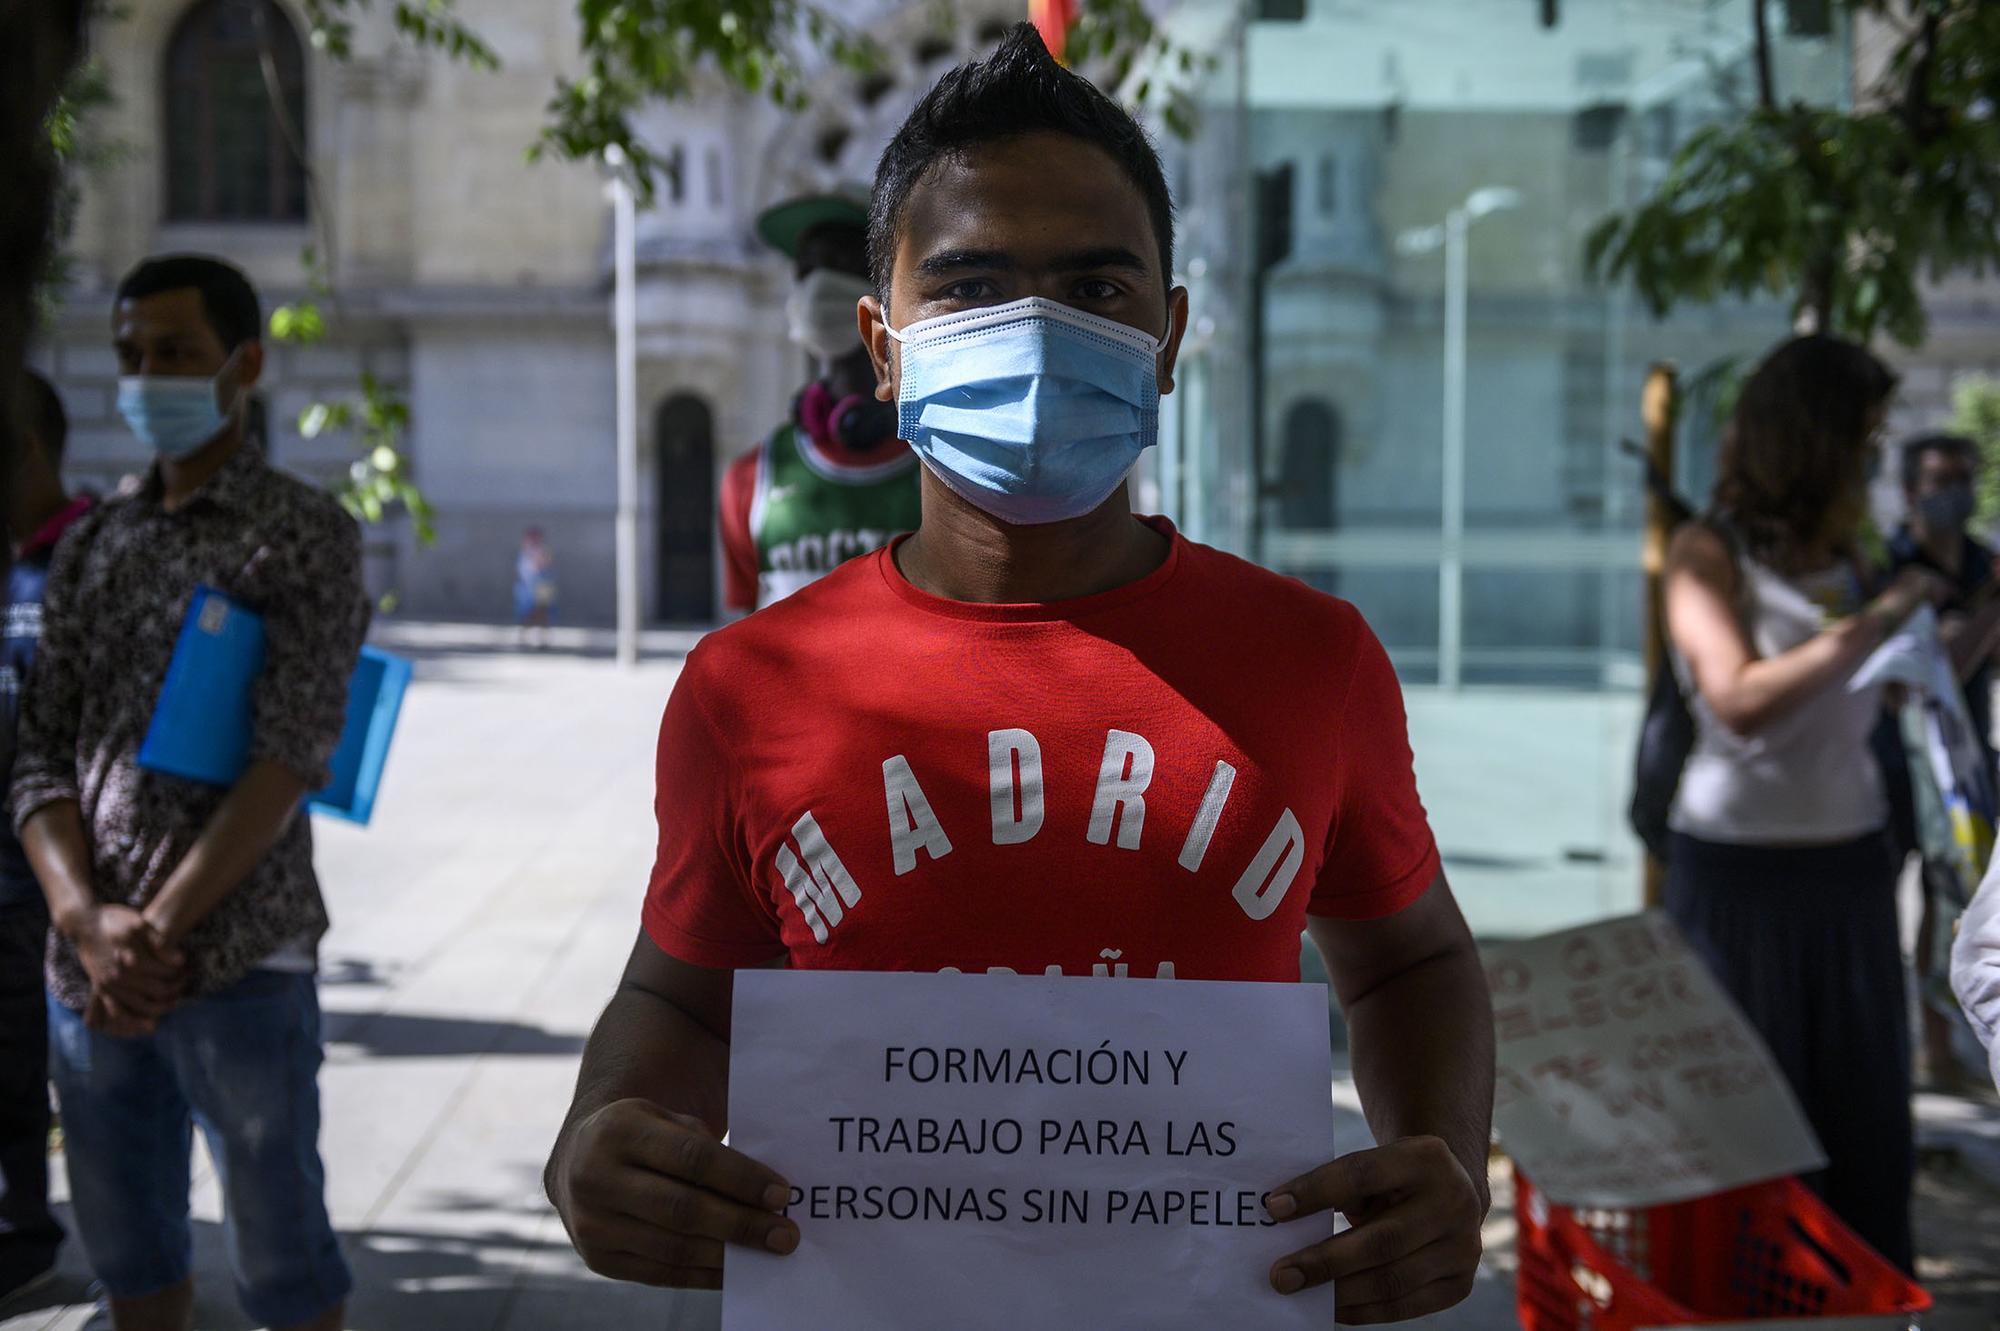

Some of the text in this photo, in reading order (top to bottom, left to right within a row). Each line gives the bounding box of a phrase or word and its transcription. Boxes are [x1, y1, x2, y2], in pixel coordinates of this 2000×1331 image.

[775, 727, 1305, 945] MADRID
[885, 1039, 1188, 1086] FORMACIÓN Y
[828, 1117, 1237, 1157] TRABAJO PARA LAS
[782, 1185, 1278, 1228] PERSONAS SIN PAPELES
